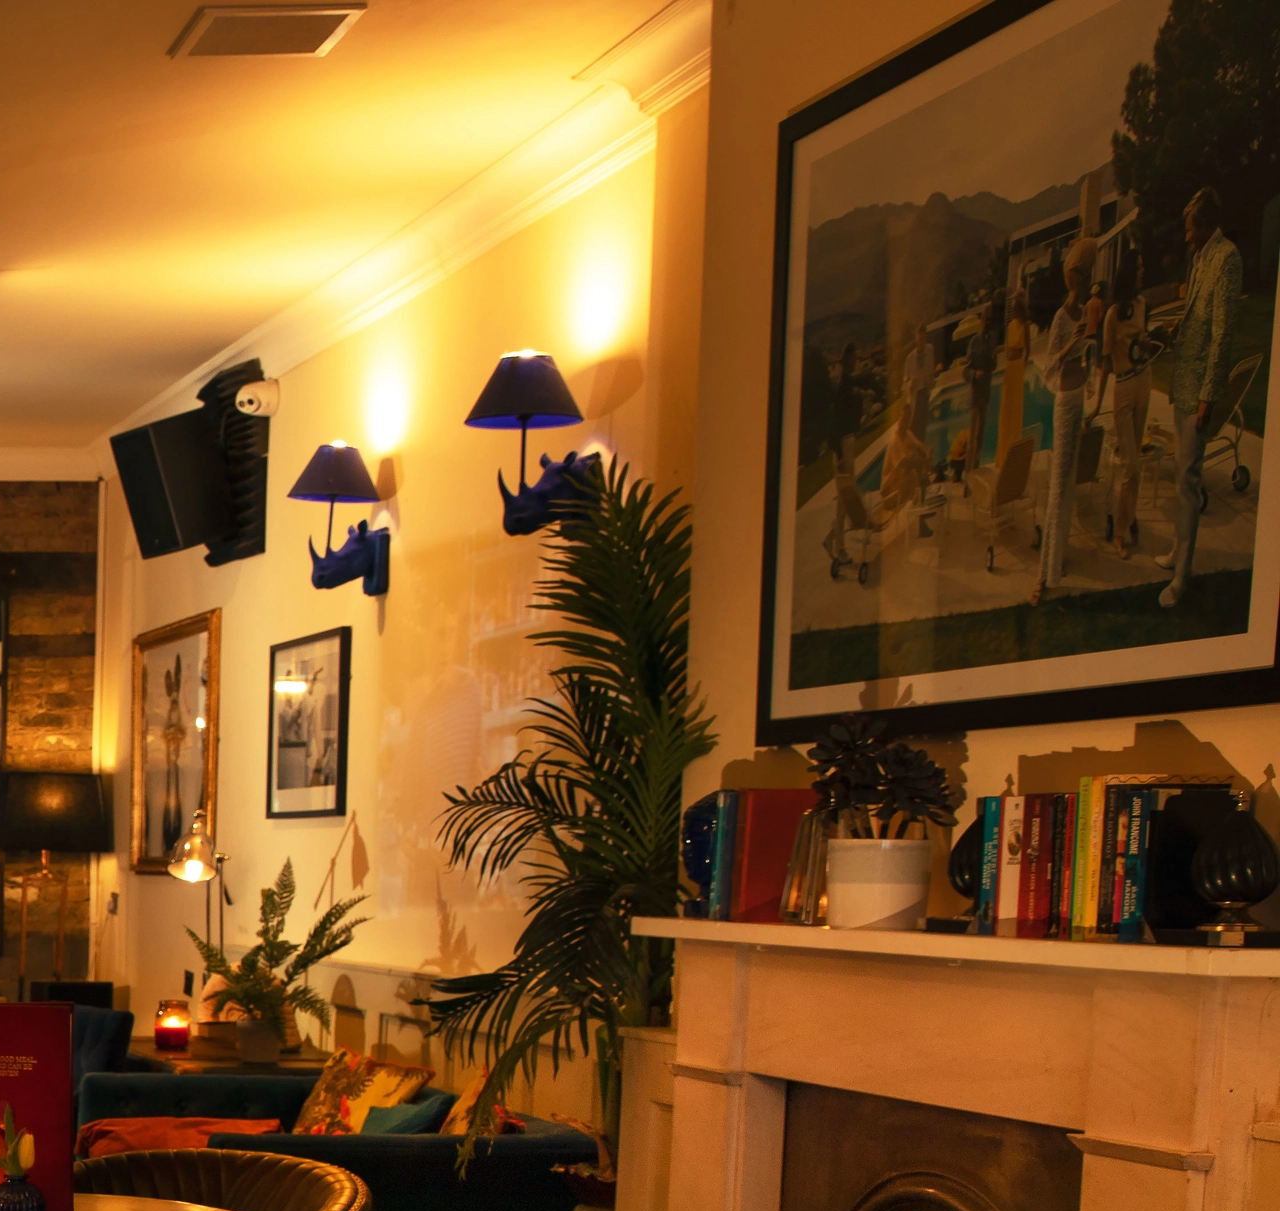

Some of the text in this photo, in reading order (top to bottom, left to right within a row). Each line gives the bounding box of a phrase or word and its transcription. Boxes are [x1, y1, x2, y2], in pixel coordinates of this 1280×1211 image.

[1128, 796, 1142, 855] JOHN FRANCOME
[1122, 879, 1132, 919] HANDER
[1129, 885, 1139, 913] BACK
